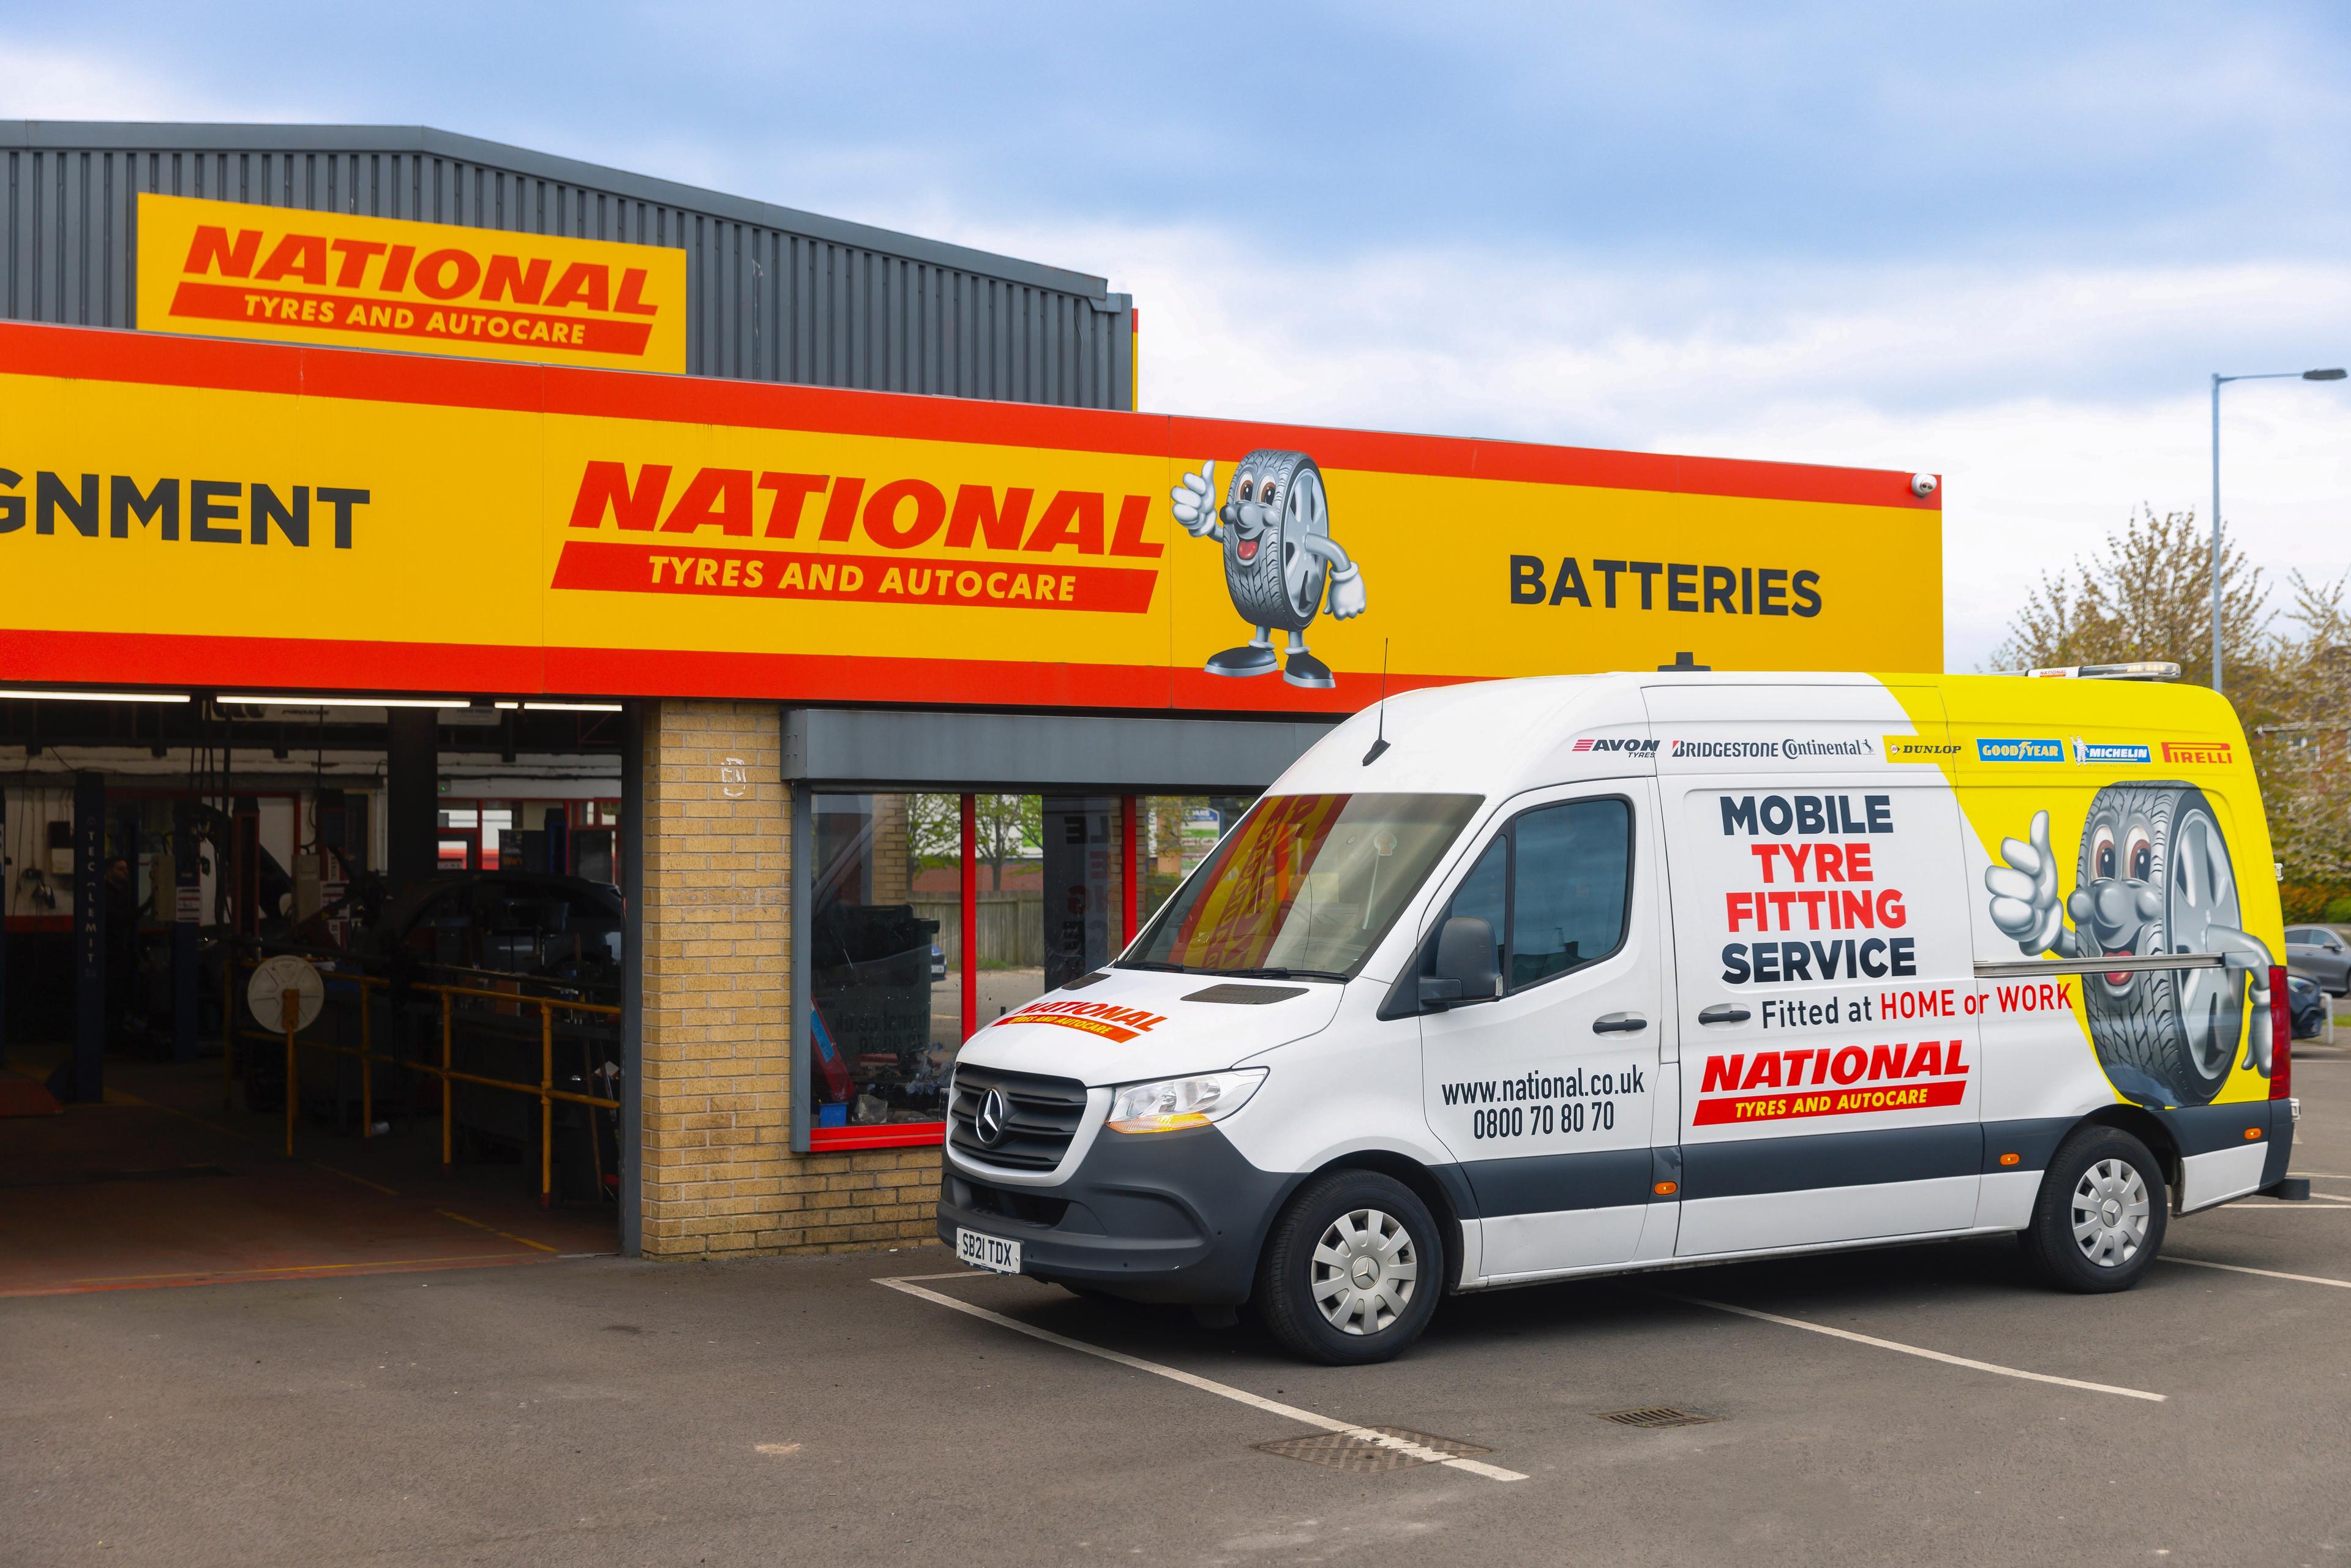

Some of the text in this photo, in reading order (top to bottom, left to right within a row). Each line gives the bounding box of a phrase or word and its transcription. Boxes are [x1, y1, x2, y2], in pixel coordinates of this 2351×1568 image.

[184, 225, 658, 316] NATIONAL
[244, 294, 585, 345] TYRES AND AUTOCARE
[569, 460, 1164, 558] NATIONAL
[649, 555, 1076, 602] TYRES AND AUTOCARE
[1510, 554, 1822, 618] BATTERIES
[1592, 739, 1660, 751] AVON
[1672, 740, 1779, 757] BRIDGESTONE
[1782, 738, 1862, 760] Continental
[1903, 745, 1961, 754] DUNLOP
[2089, 748, 2148, 758] MICHELIN
[2161, 742, 2233, 763] PIRELLI
[1720, 795, 1894, 836] MOBILE
[1751, 842, 1873, 883] TYRE
[1726, 889, 1907, 932] FITTING
[1721, 937, 1916, 985] SERVICE
[1012, 1002, 1168, 1032] NATIONAL
[1054, 1017, 1113, 1033] AUTOCARE
[1763, 983, 2073, 1029] Fitted at HOME or WORK
[1442, 1064, 1644, 1105] www.national.co.uk
[1701, 1040, 1970, 1093] NATIONAL
[1474, 1101, 1614, 1139] 0800 70 80 70
[1735, 1088, 1928, 1119] TYRES AND AUTOCARE
[963, 1233, 1011, 1266] SB21 TDX
